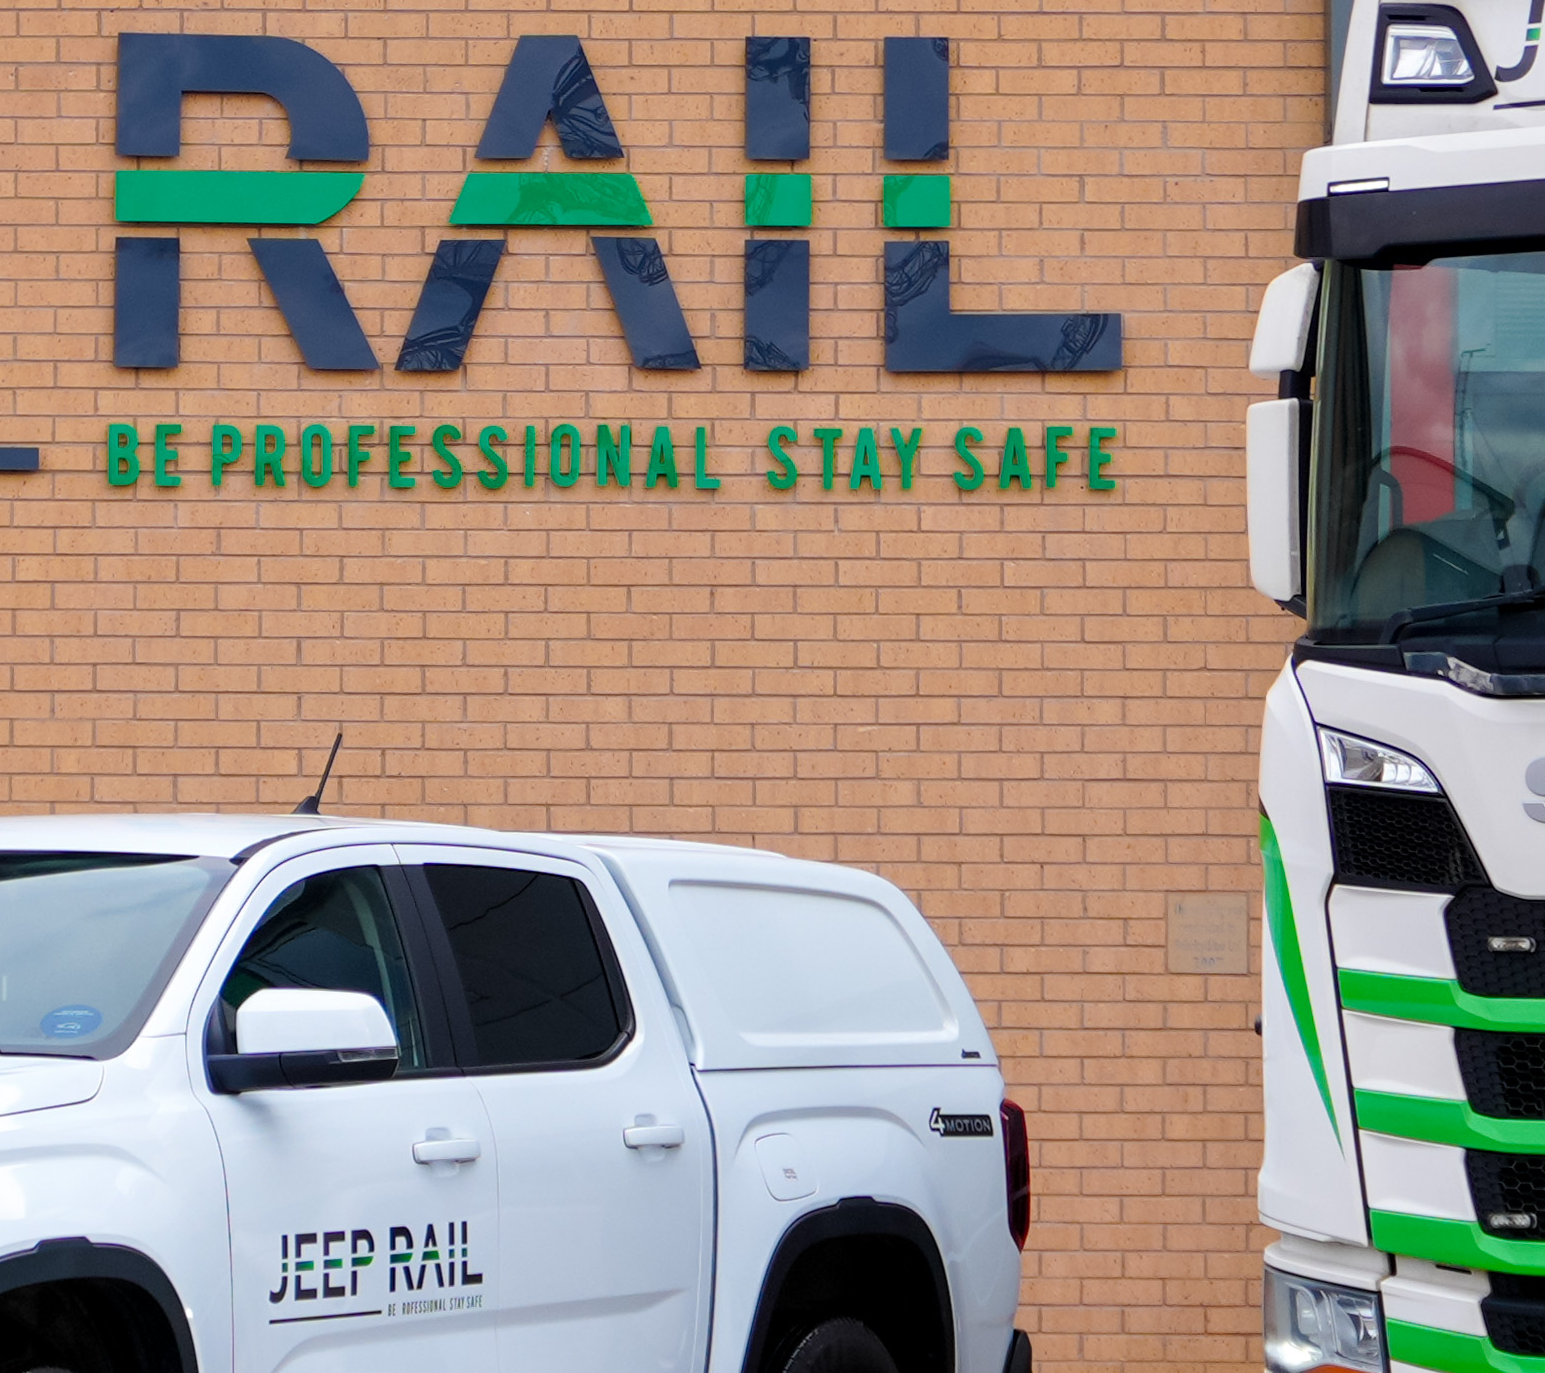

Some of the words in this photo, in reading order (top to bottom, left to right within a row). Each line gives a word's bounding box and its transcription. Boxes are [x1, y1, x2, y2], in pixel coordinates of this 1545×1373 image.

[113, 31, 1122, 372] RAIL
[108, 423, 183, 489] BE
[211, 423, 721, 491] PROFESSIONAL
[766, 425, 923, 492] STAY
[952, 426, 1118, 493] SAFE
[269, 1229, 375, 1304] JEEP
[389, 1220, 484, 1293] RAIL
[388, 1303, 397, 1317] BE
[449, 1296, 466, 1311] STAY
[466, 1294, 483, 1308] SAFE
